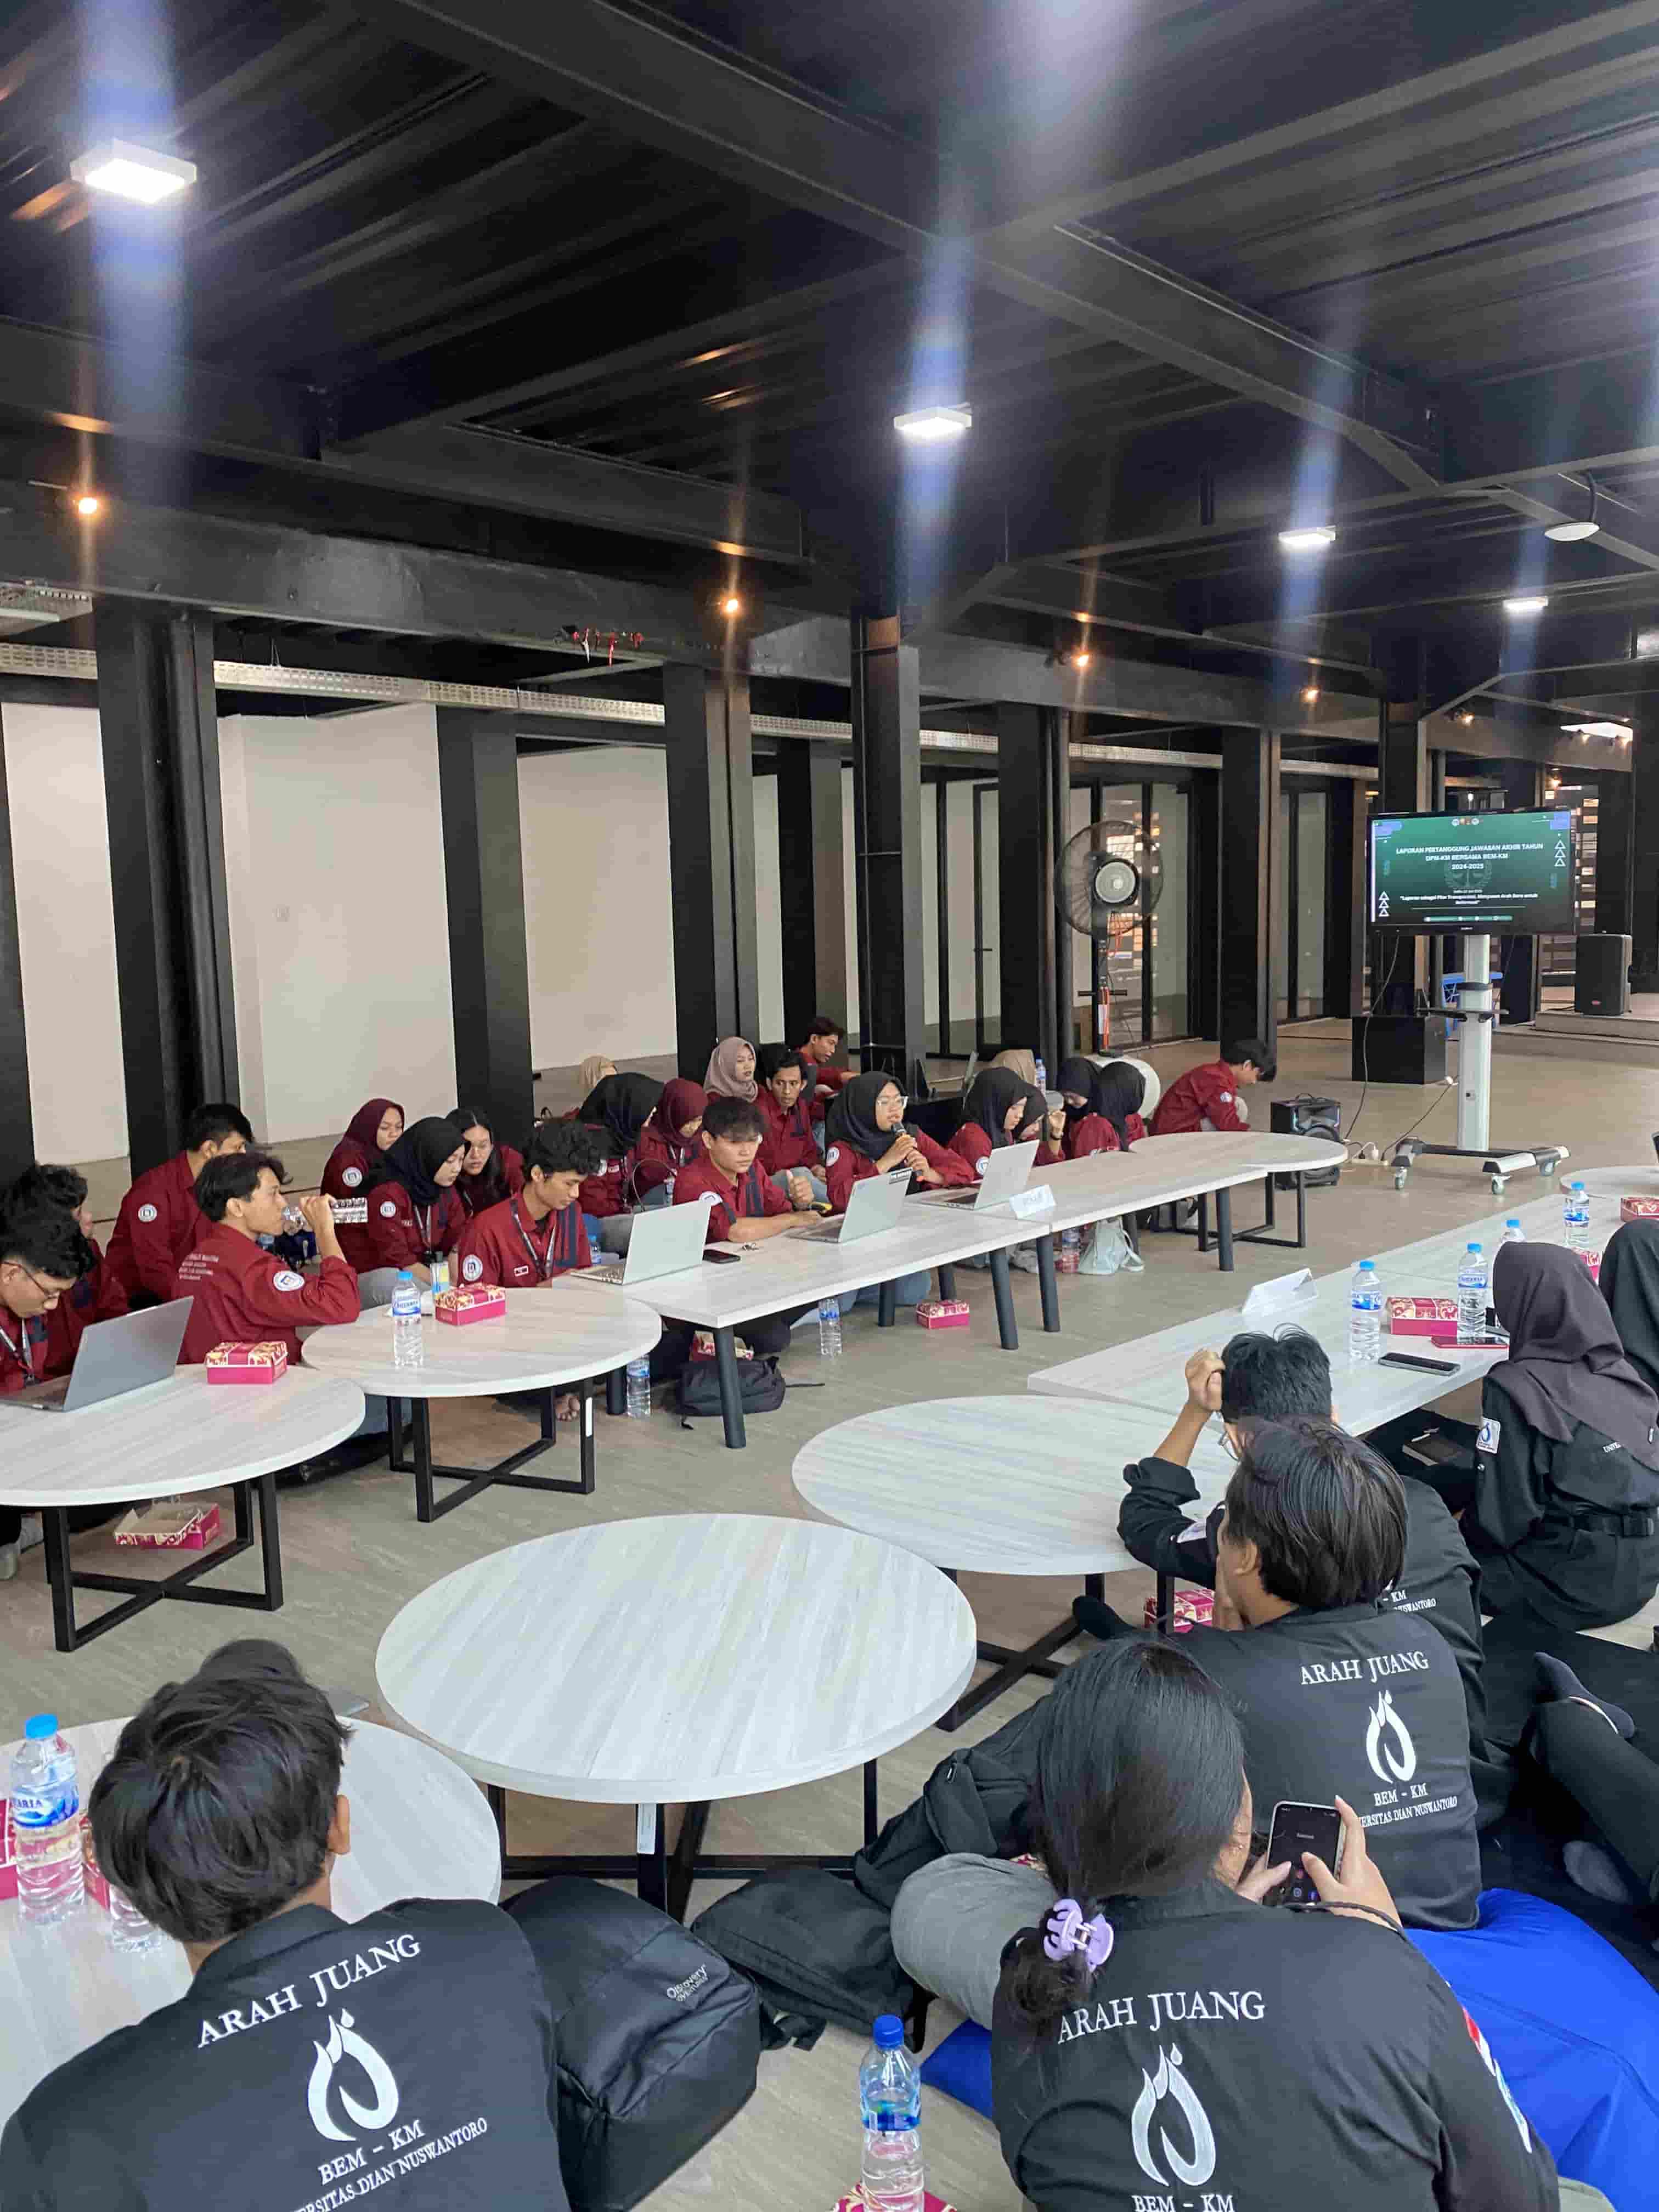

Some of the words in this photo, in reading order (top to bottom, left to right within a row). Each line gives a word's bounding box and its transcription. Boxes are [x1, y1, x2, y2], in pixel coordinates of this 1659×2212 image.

[1391, 1589, 1408, 1602] KM
[1301, 1660, 1363, 1685] ARAH
[1367, 1651, 1429, 1683] JUANG
[1373, 1790, 1398, 1806] BEM
[1410, 1783, 1427, 1798] KM
[1393, 1807, 1413, 1821] DIAN
[1414, 1796, 1458, 1817] NUSWANTORO
[198, 1984, 302, 2049] ARAH
[309, 1934, 421, 2007] JUANG
[1057, 1996, 1137, 2045] ARAH
[1147, 1990, 1266, 2032] JUANG
[318, 2147, 368, 2185] BEM
[388, 2119, 426, 2151] KM
[357, 2165, 396, 2195] DIAN
[398, 2117, 488, 2175] NUSWANTORO
[1131, 2196, 1177, 2212] BEM
[1200, 2194, 1235, 2212] KM
